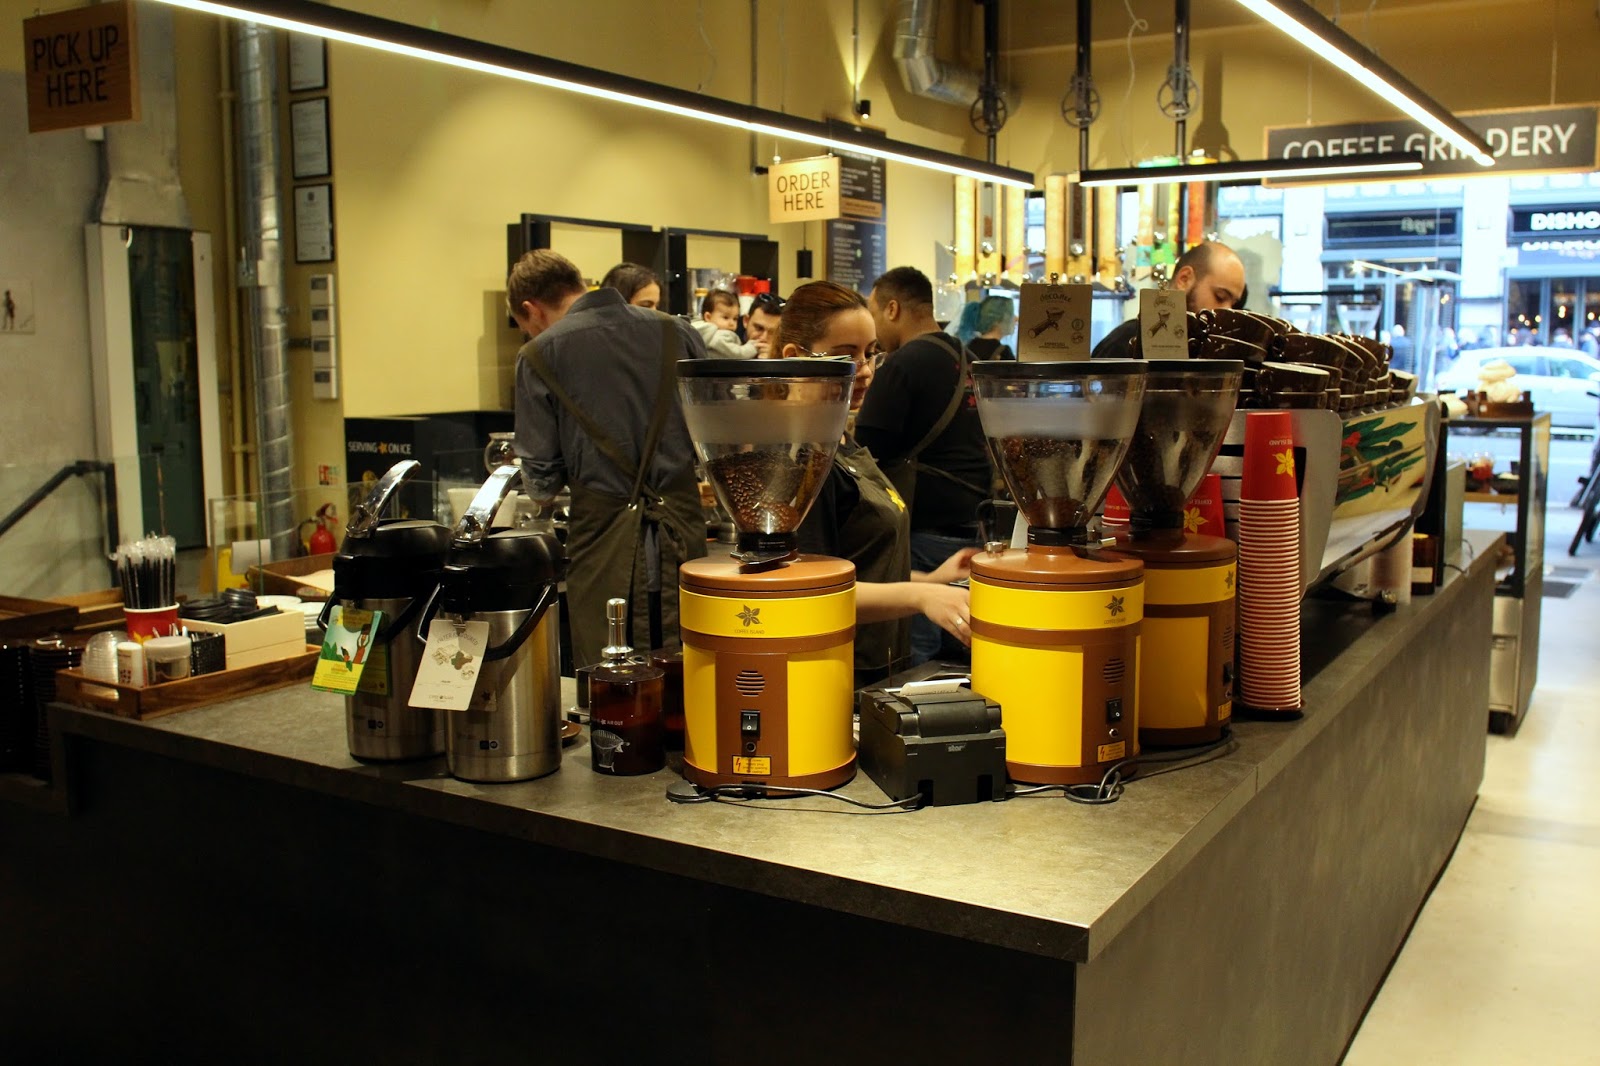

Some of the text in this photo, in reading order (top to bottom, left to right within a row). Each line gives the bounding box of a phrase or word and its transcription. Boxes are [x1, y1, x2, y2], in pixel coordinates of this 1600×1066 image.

[33, 24, 119, 72] PICK UP
[47, 66, 107, 107] HERE
[1404, 122, 1577, 161] GRIDERY
[777, 171, 830, 193] ORDER
[784, 191, 825, 212] HERE
[348, 441, 378, 453] SERVING
